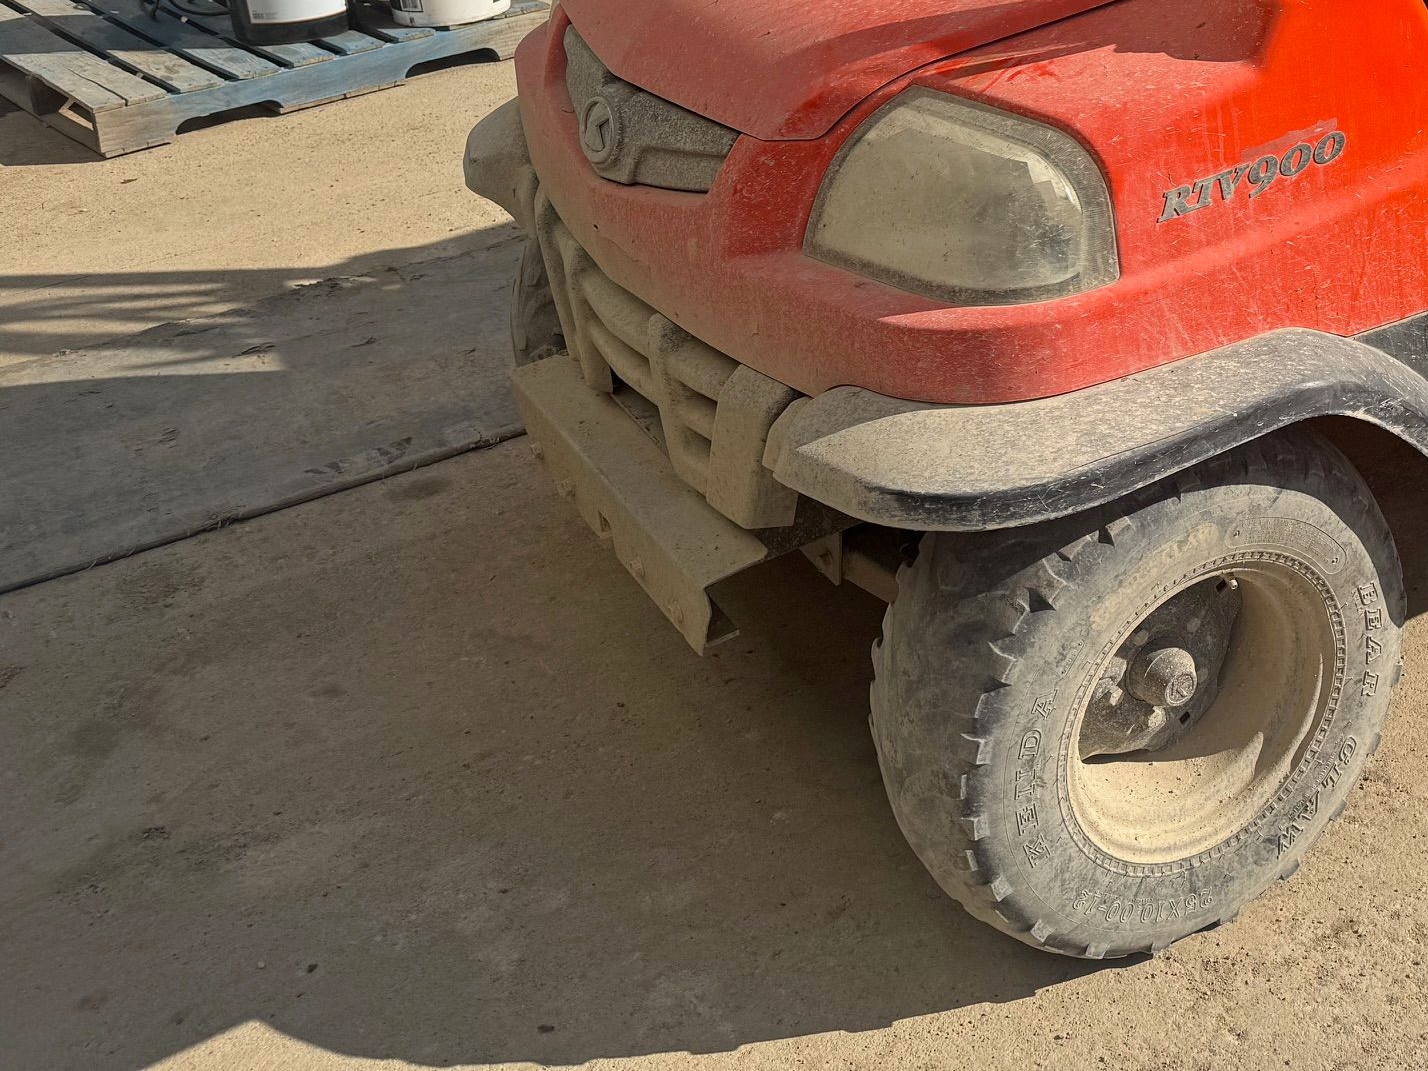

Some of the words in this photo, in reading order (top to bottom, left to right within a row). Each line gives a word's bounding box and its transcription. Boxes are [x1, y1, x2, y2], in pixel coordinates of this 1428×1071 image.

[1155, 130, 1346, 224] RTV900
[1357, 580, 1382, 697] BEAR
[1014, 688, 1058, 869] KENDA
[1276, 736, 1357, 861] CLAW
